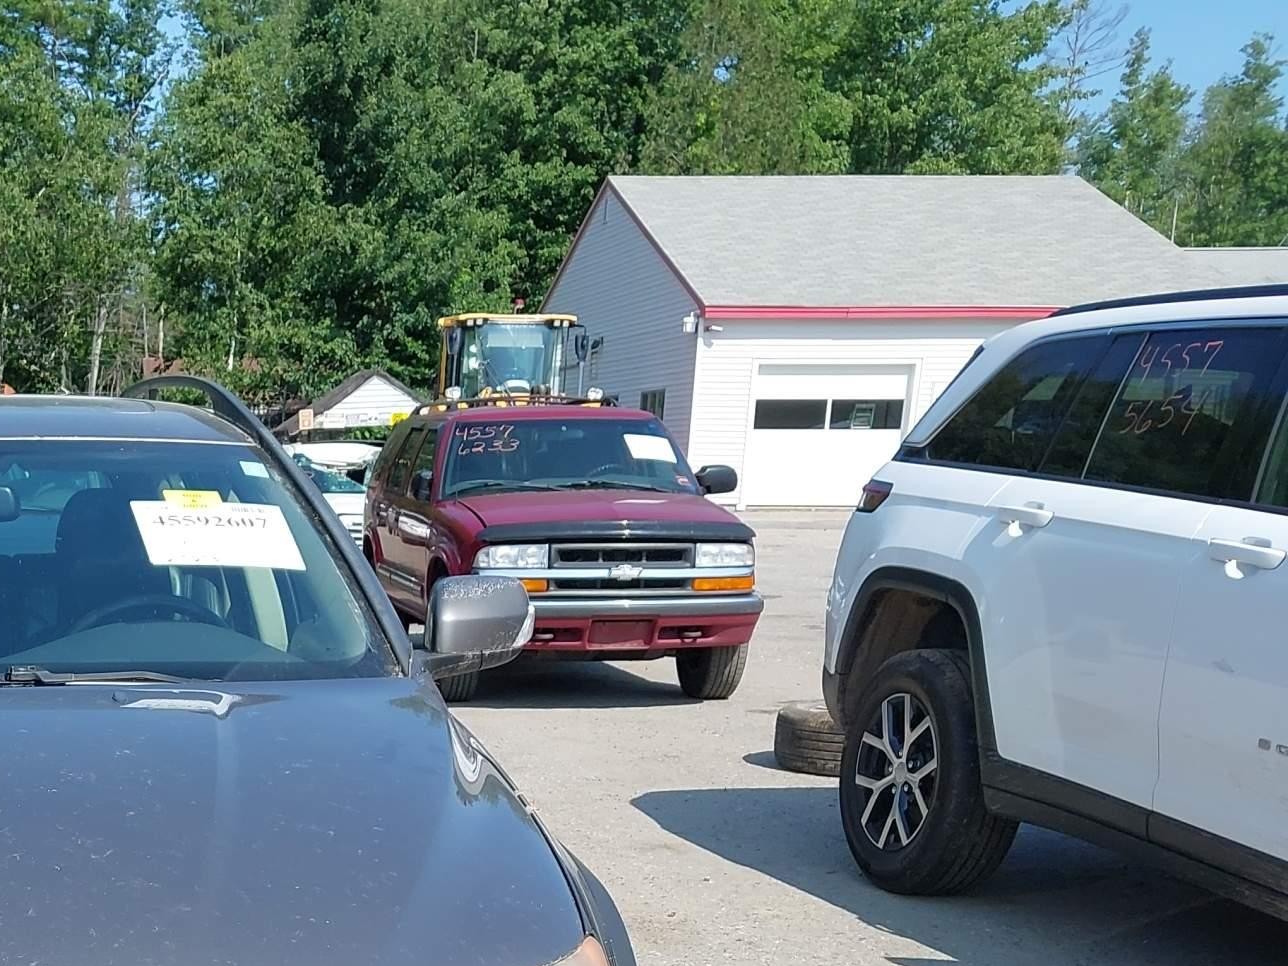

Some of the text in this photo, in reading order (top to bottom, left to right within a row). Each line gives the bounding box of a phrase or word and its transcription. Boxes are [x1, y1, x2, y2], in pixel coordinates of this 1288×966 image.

[1140, 340, 1224, 384] 4557
[1119, 391, 1210, 436] 5654
[455, 424, 515, 441] 4557
[458, 438, 520, 456] 6233
[152, 515, 267, 529] 45592607
